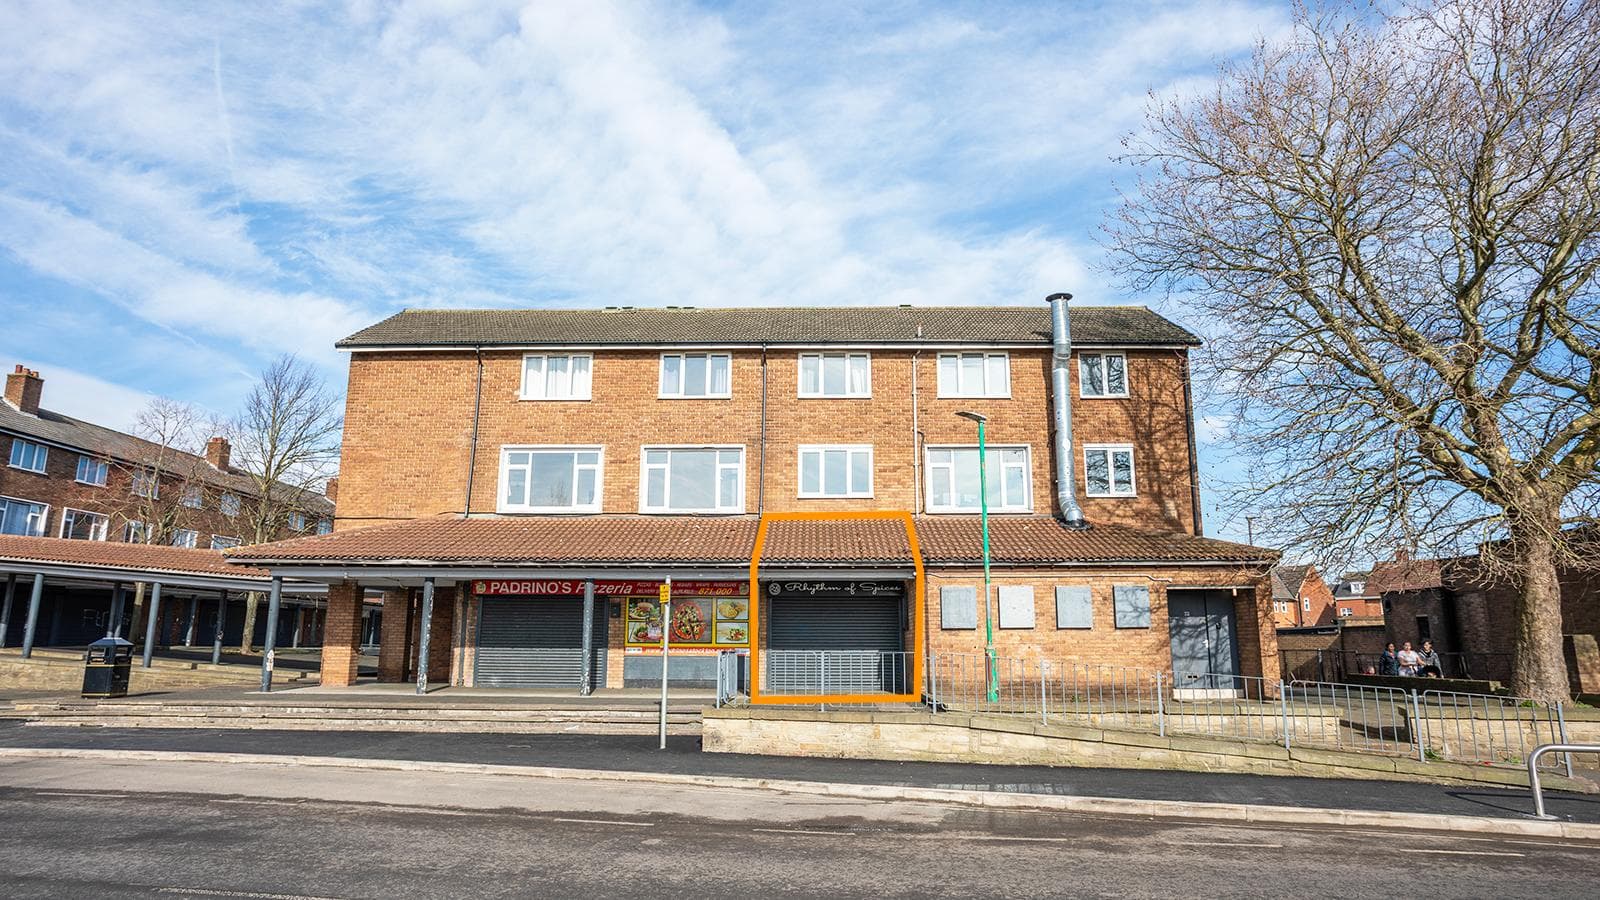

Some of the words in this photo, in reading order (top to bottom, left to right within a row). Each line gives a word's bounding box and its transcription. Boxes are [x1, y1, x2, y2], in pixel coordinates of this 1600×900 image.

[490, 581, 572, 594] PADRINO'S
[575, 581, 633, 594] Pzzeria
[715, 587, 733, 595] 000
[785, 582, 841, 595] Rhythm
[844, 582, 857, 595] of
[859, 582, 901, 595] Spices
